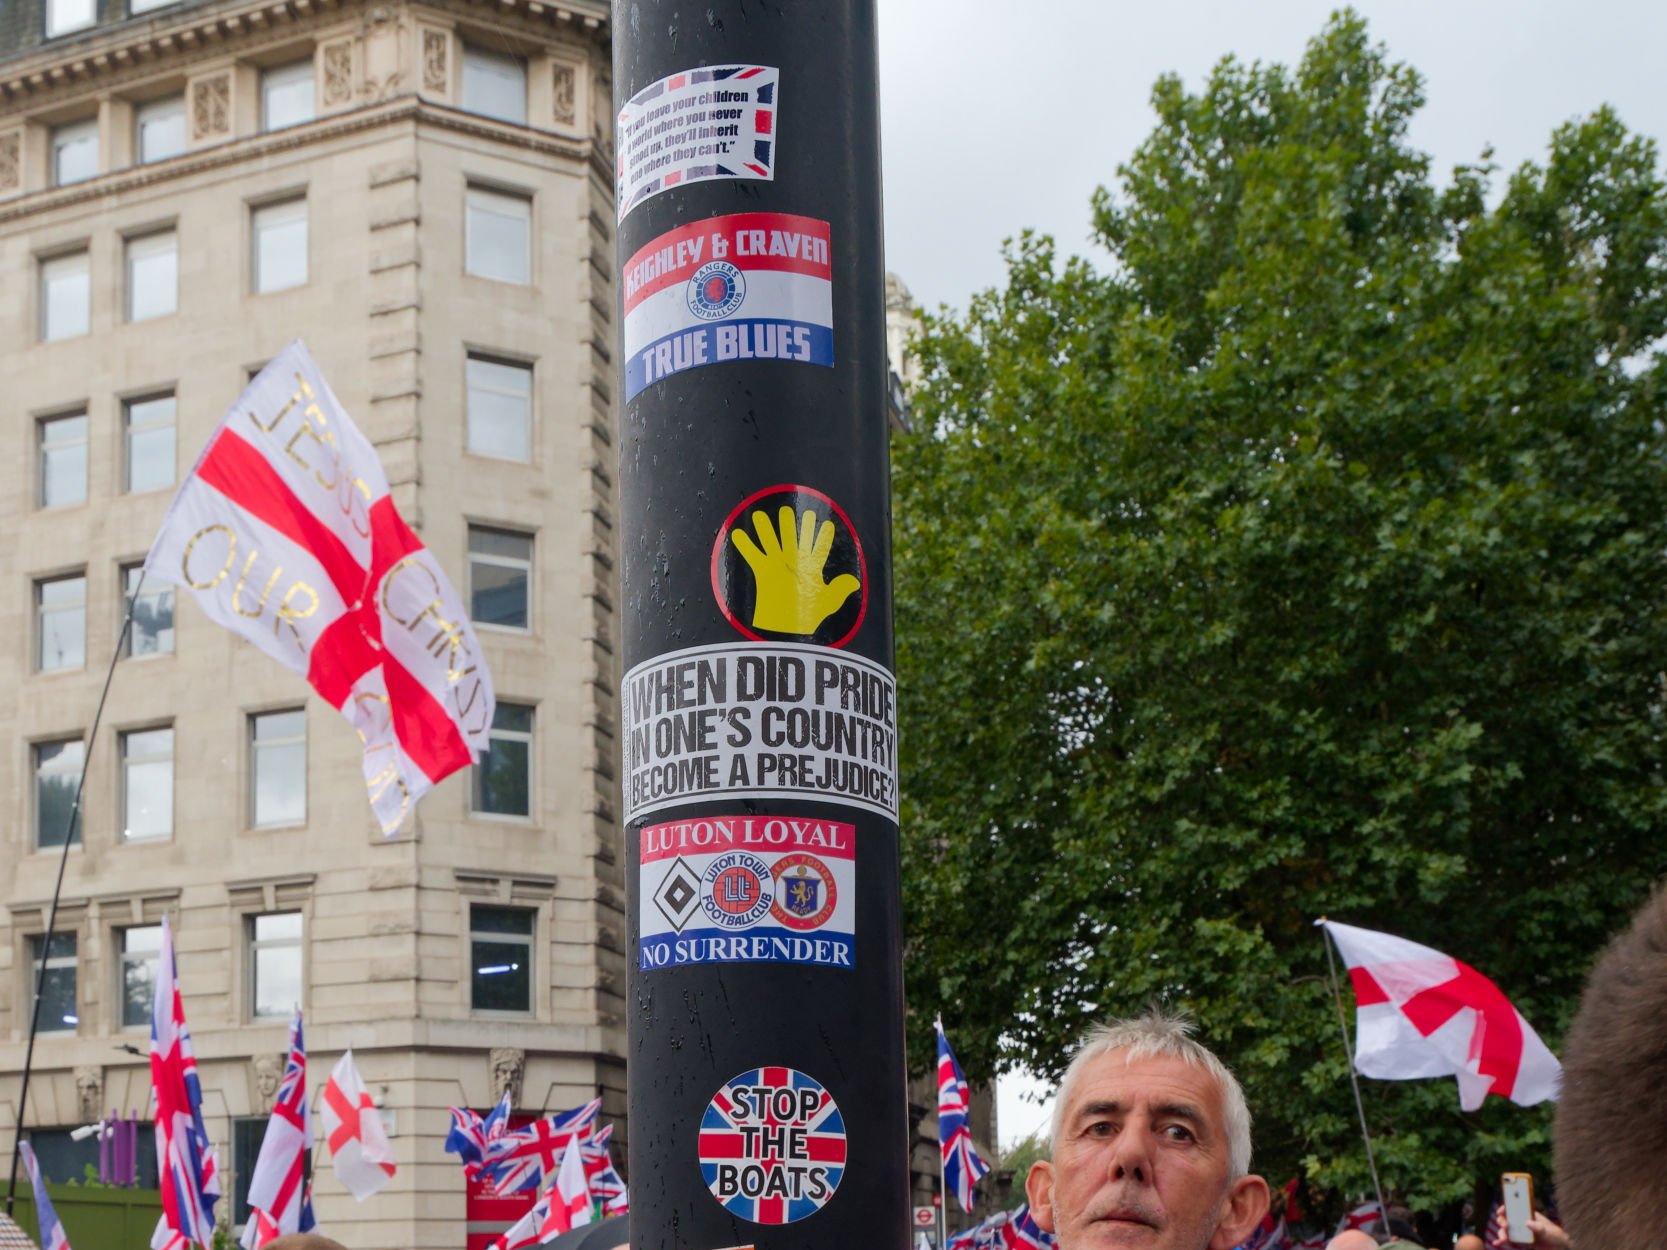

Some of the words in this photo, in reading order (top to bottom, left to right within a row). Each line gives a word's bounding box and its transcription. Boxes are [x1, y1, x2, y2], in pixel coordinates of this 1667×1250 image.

[646, 104, 671, 123] leave
[672, 97, 697, 113] your
[698, 91, 749, 105] children
[632, 128, 653, 148] world
[654, 116, 684, 136] where
[686, 111, 706, 126] you
[708, 108, 743, 121] never
[665, 128, 697, 149] they'll
[698, 124, 739, 140] inherit
[643, 153, 671, 175] where
[673, 146, 697, 162] they
[626, 234, 705, 300] KEIGHLEY
[711, 232, 730, 258] &
[736, 230, 829, 265] CRAVEN
[693, 262, 740, 284] RANGERS
[690, 299, 727, 318] FOOTBALL
[726, 292, 743, 312] CLUB
[641, 329, 708, 385] TRUE
[716, 323, 812, 363] BLUES
[181, 524, 319, 654] OUR
[631, 658, 728, 725] WHEN
[736, 655, 806, 703] DID
[814, 659, 895, 730] PRIDE
[631, 721, 650, 771] IN
[654, 706, 752, 760] ONE'S
[761, 705, 895, 773] COUNTRY
[631, 754, 721, 808] BECOME
[728, 752, 751, 787] A
[757, 752, 896, 808] PREJUDICE?
[645, 819, 736, 854] LUTON
[744, 819, 847, 850] LOYAL
[704, 854, 737, 884] LUTON
[738, 854, 771, 882] TOWN
[702, 894, 754, 927] FOOTBALL
[751, 892, 773, 919] CLUB
[642, 942, 671, 969] NO
[674, 936, 851, 966] SURRENDER
[730, 1087, 821, 1121] STOP
[739, 1126, 809, 1160] THE
[719, 1164, 828, 1200] BOATS
